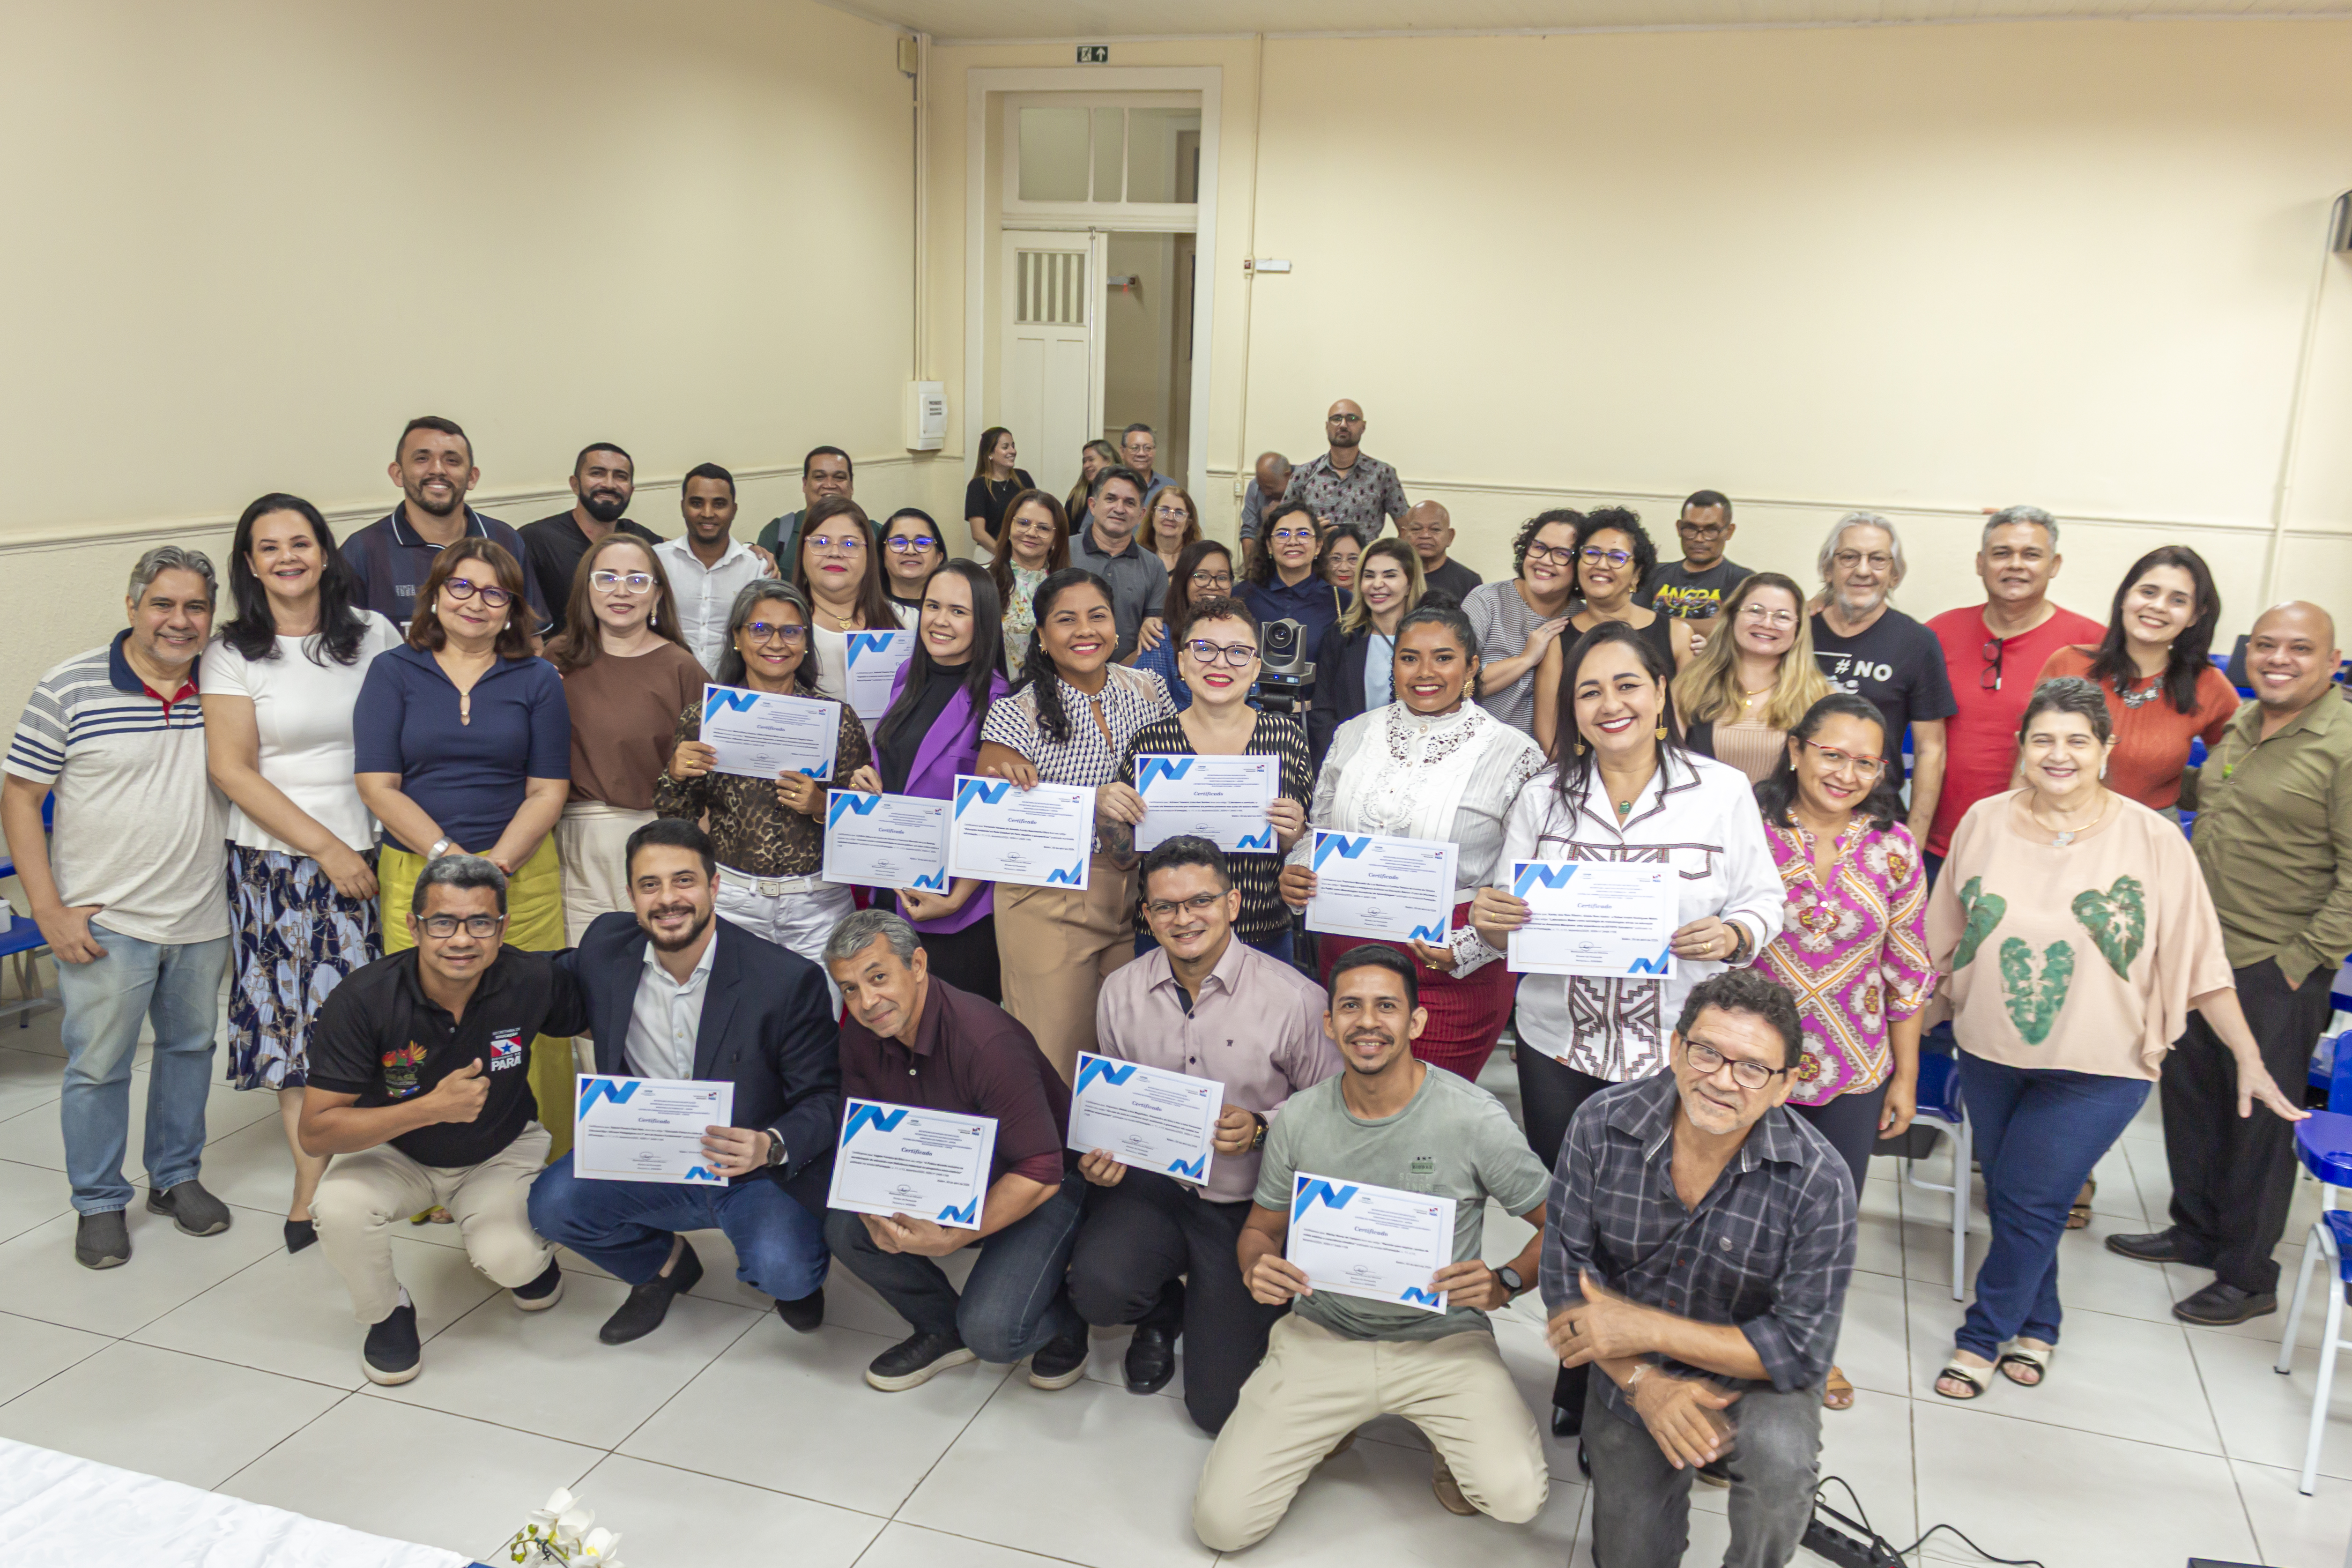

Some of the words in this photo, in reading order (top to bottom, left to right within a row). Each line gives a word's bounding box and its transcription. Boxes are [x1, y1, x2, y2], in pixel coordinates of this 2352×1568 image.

[1132, 1100, 1162, 1112] Certificado
[901, 1147, 933, 1156] Certificado
[1354, 1226, 1388, 1237] Certificado
